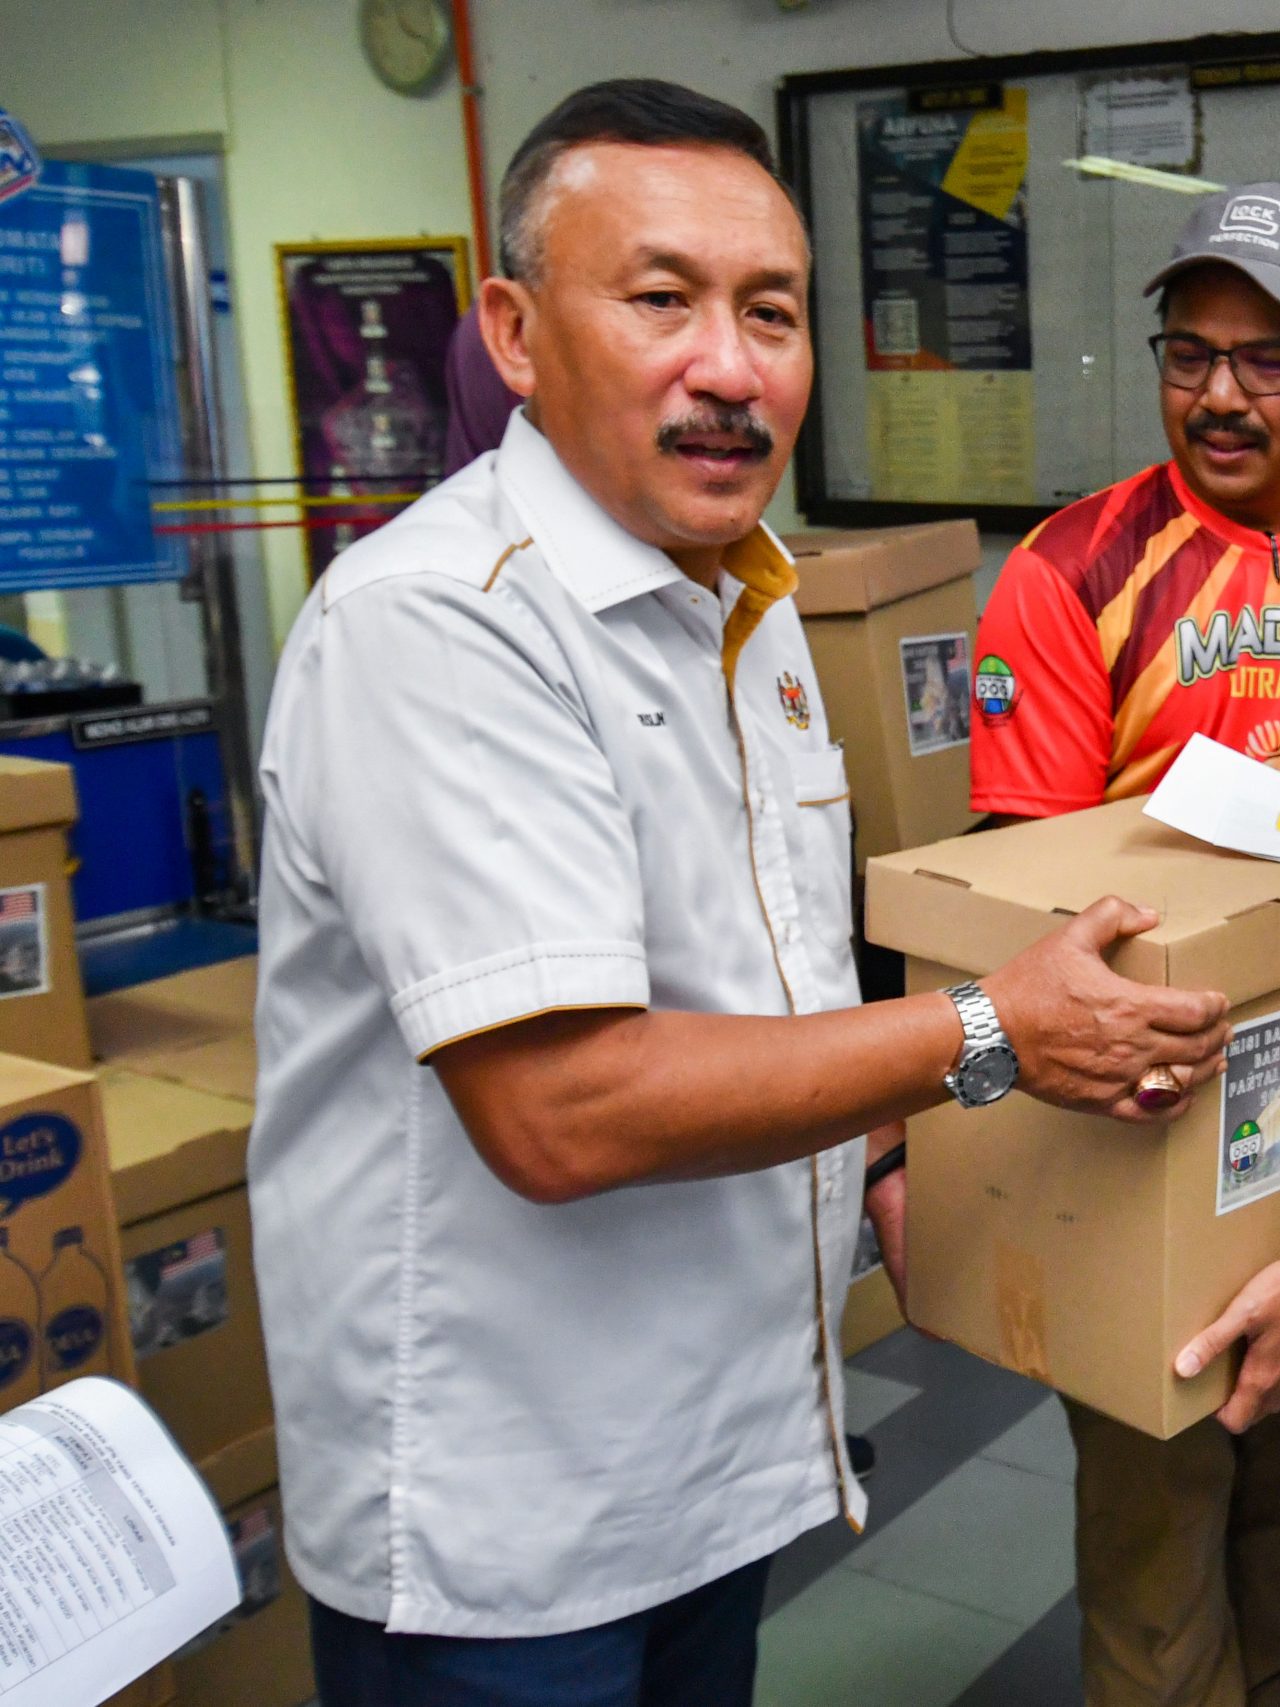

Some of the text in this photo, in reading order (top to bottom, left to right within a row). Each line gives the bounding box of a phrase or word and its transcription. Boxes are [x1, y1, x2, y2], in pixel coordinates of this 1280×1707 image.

[1228, 1033, 1260, 1057] MISI
[1228, 1066, 1280, 1098] PANTAI
[122, 1514, 145, 1543] LOKASI
